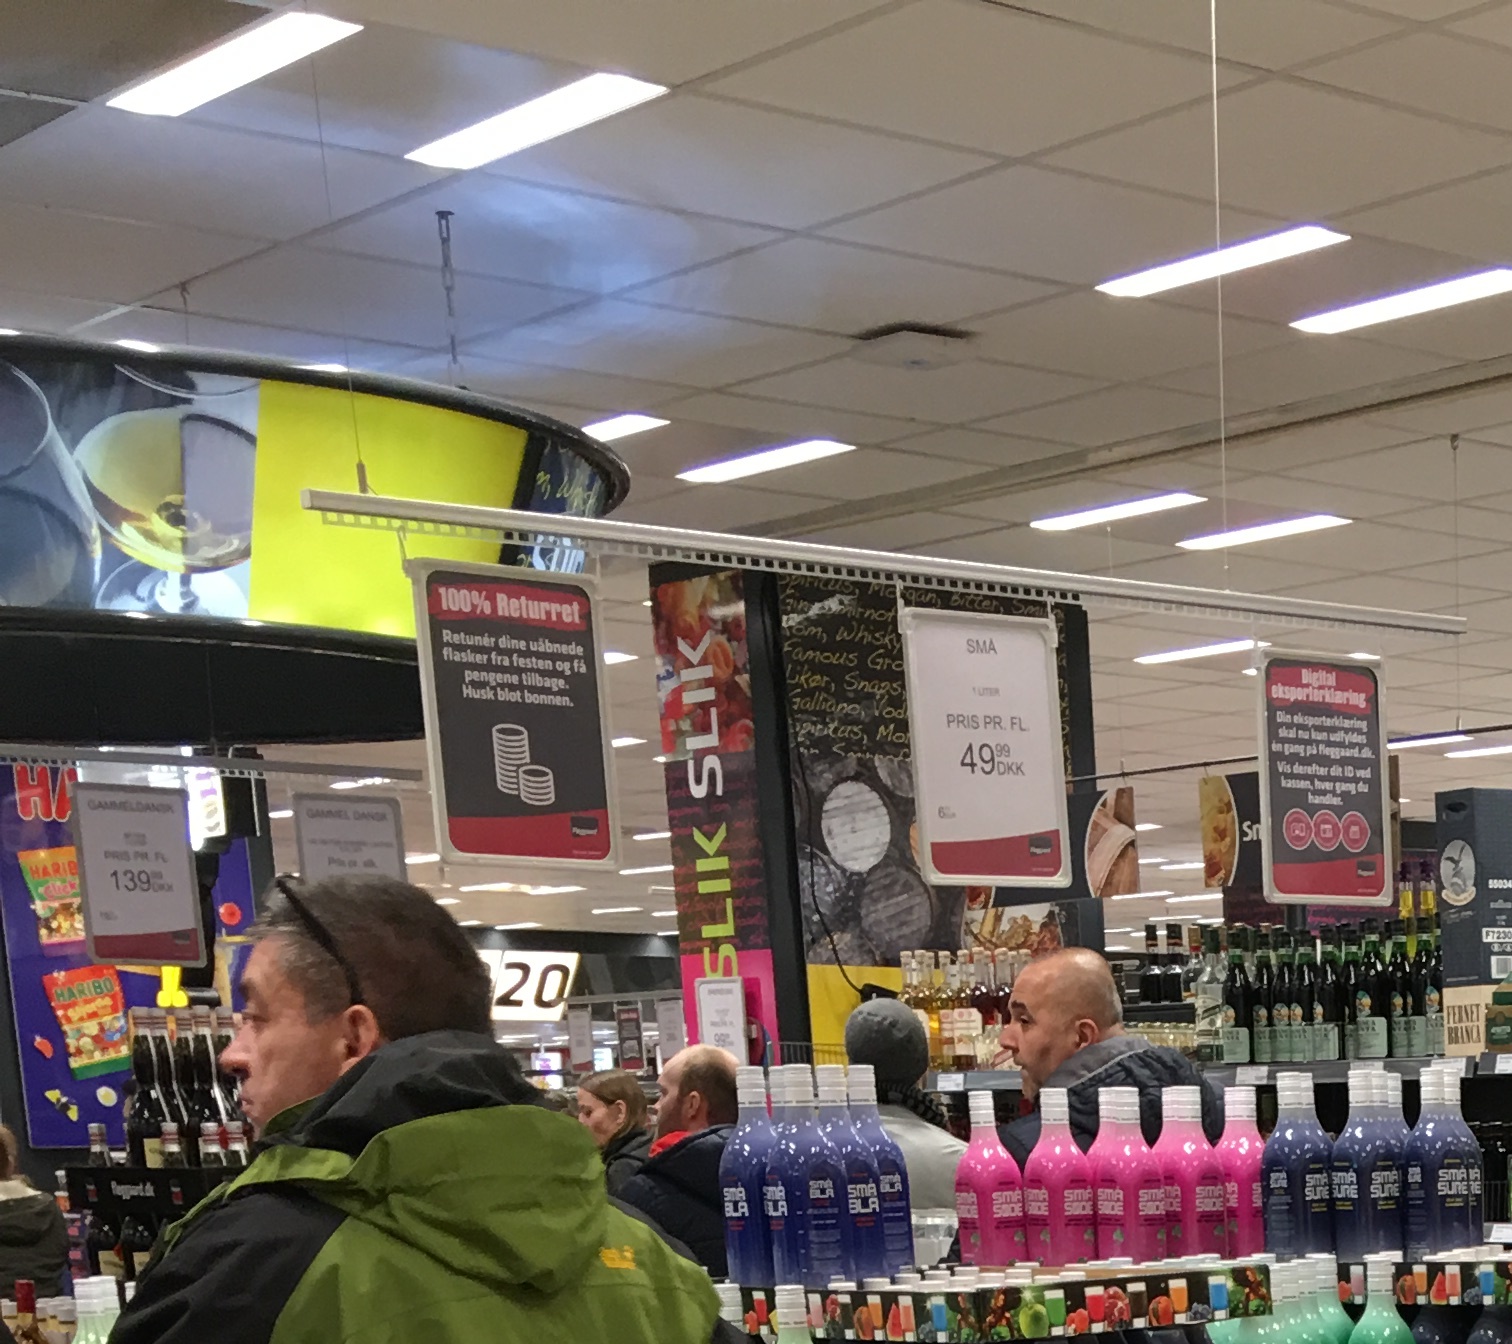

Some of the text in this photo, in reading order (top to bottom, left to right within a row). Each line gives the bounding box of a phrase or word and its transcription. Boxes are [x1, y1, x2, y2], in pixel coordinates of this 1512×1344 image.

[438, 587, 581, 624] 100% Returret
[499, 635, 527, 650] dine
[530, 638, 584, 656] uåbnede
[966, 638, 998, 655] SMÅ
[443, 648, 586, 675] flasker fra festen og få
[464, 669, 569, 691] pengene tilbage.
[1301, 669, 1337, 687] Digital
[462, 685, 574, 707] Husk blot bonnen.
[1271, 683, 1366, 708] eksporterklæring
[677, 631, 723, 799] SLIK
[947, 714, 980, 729] PRIS
[984, 715, 1006, 731] PR.
[1276, 711, 1367, 732] Din eksporterklæring
[1279, 725, 1297, 738] skal
[1330, 730, 1366, 745] udfyldes
[960, 742, 995, 775] 49
[997, 762, 1025, 776] DKK
[1293, 762, 1328, 776] derefter
[109, 870, 151, 893] 139
[692, 822, 738, 978] SLIK
[54, 977, 114, 1003] HARIBO
